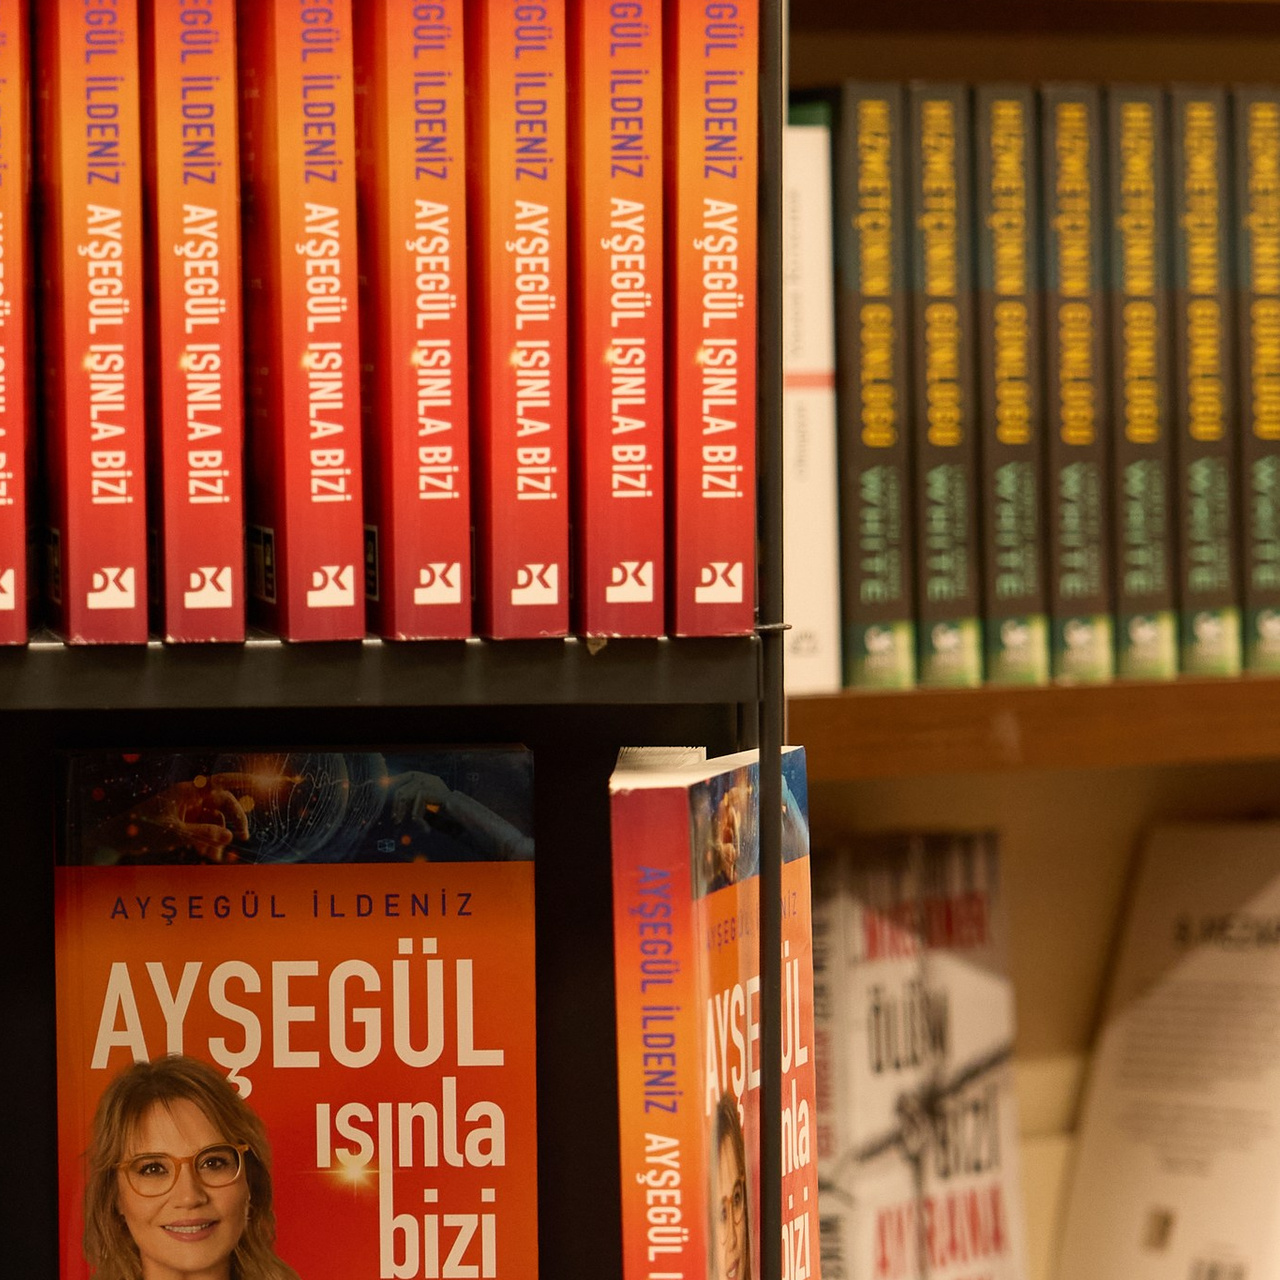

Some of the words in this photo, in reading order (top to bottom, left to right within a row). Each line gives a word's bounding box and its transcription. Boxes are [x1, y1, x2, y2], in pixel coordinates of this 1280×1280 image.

[86, 76, 126, 185] İLDENİZ
[181, 76, 222, 185] İLDENİZ
[302, 75, 343, 184] İLDENİZ
[414, 71, 453, 180] İLDENİZ
[515, 72, 554, 181] İLDENİZ
[610, 69, 650, 179] İLDENİZ
[704, 70, 744, 179] İLDENİZ
[76, 204, 130, 335] AYŞEGÜL
[172, 204, 226, 335] AYŞEGÜL
[294, 202, 347, 333] AYŞEGÜL
[403, 199, 457, 330] AYŞEGÜL
[503, 200, 556, 331] AYŞEGÜL
[598, 198, 652, 328] AYŞEGÜL
[690, 198, 744, 328] AYŞEGÜL
[91, 450, 133, 505] BİZİ
[187, 450, 230, 505] BİZİ
[310, 449, 352, 503] BİZİ
[419, 446, 459, 500] BİZİ
[517, 447, 557, 500] BİZİ
[612, 444, 653, 499] BİZİ
[702, 445, 743, 499] BİZİ
[110, 892, 287, 926] AYŞEGÜL
[312, 890, 475, 920] İLDENİZ
[635, 863, 676, 995] AYŞEGÜL
[91, 937, 505, 1099] AYŞEGÜL
[639, 1003, 681, 1115] İLDENİZ
[379, 1187, 497, 1280] bizi
[636, 1131, 688, 1264] AYŞEGÜL
